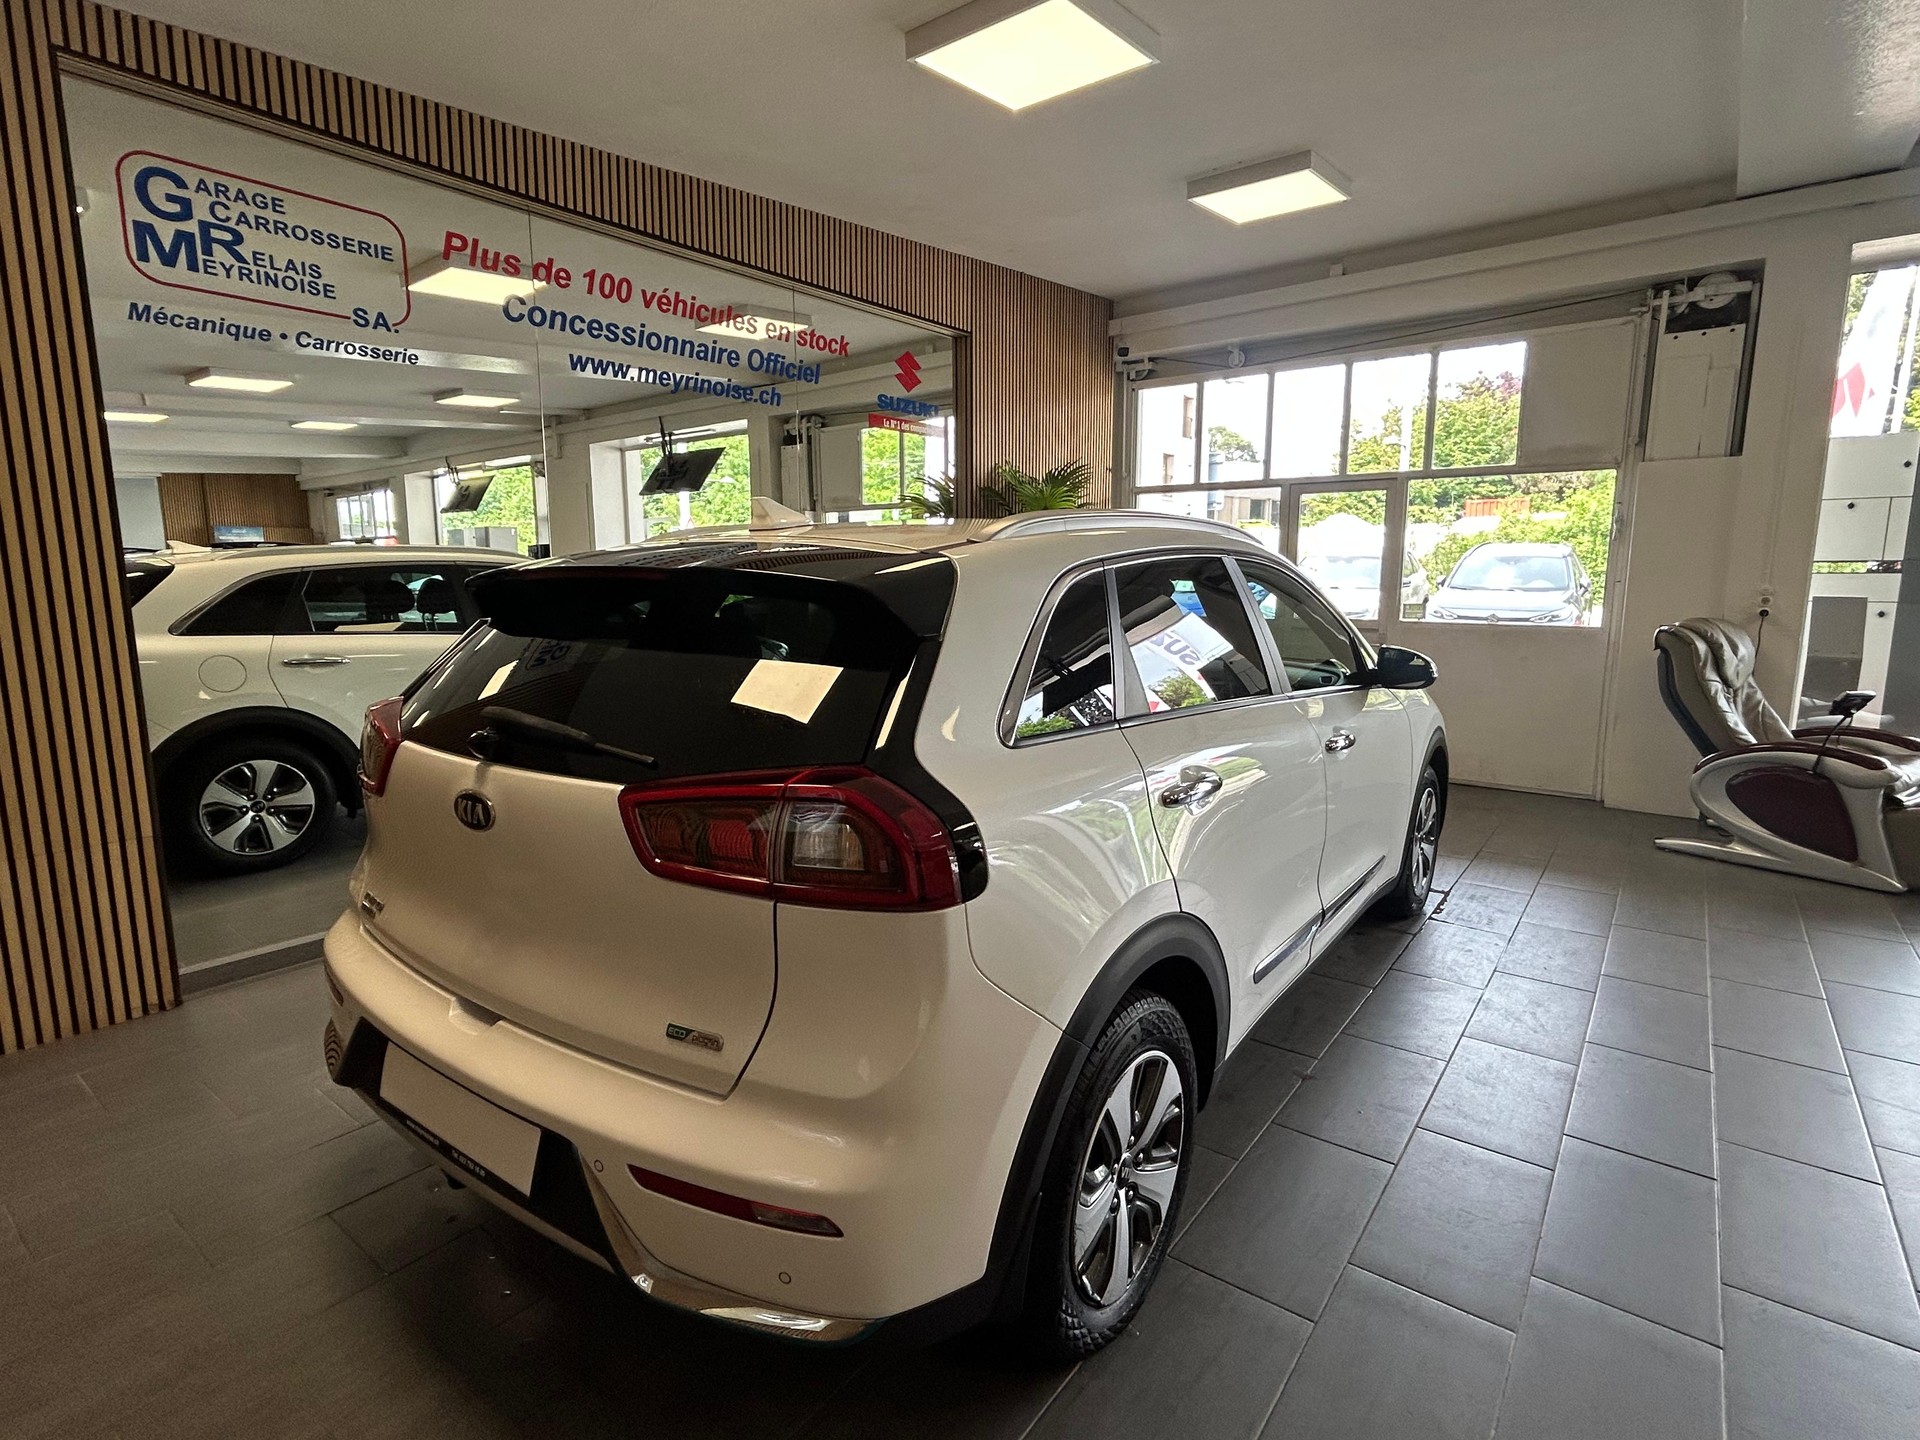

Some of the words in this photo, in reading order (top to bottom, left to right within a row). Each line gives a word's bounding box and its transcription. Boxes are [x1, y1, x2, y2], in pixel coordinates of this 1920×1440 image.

[133, 166, 286, 222] GARAGE
[132, 219, 337, 299] MEYRINOISE
[197, 218, 322, 279] RELAIS
[208, 200, 395, 262] CARROSSERIE
[442, 230, 522, 277] Plus
[532, 257, 572, 289] de
[583, 268, 633, 304] 100
[641, 288, 758, 335] véhicules
[765, 321, 790, 343] en
[796, 328, 850, 357] stock
[127, 302, 273, 342] Mécanique
[295, 331, 419, 365] Carrosserie
[502, 294, 740, 368] Concessionnaire
[747, 348, 821, 385] Officiel
[568, 353, 782, 407] www.meyrinoise.ch
[877, 393, 939, 418] SUZUKI
[457, 798, 486, 826] KIA
